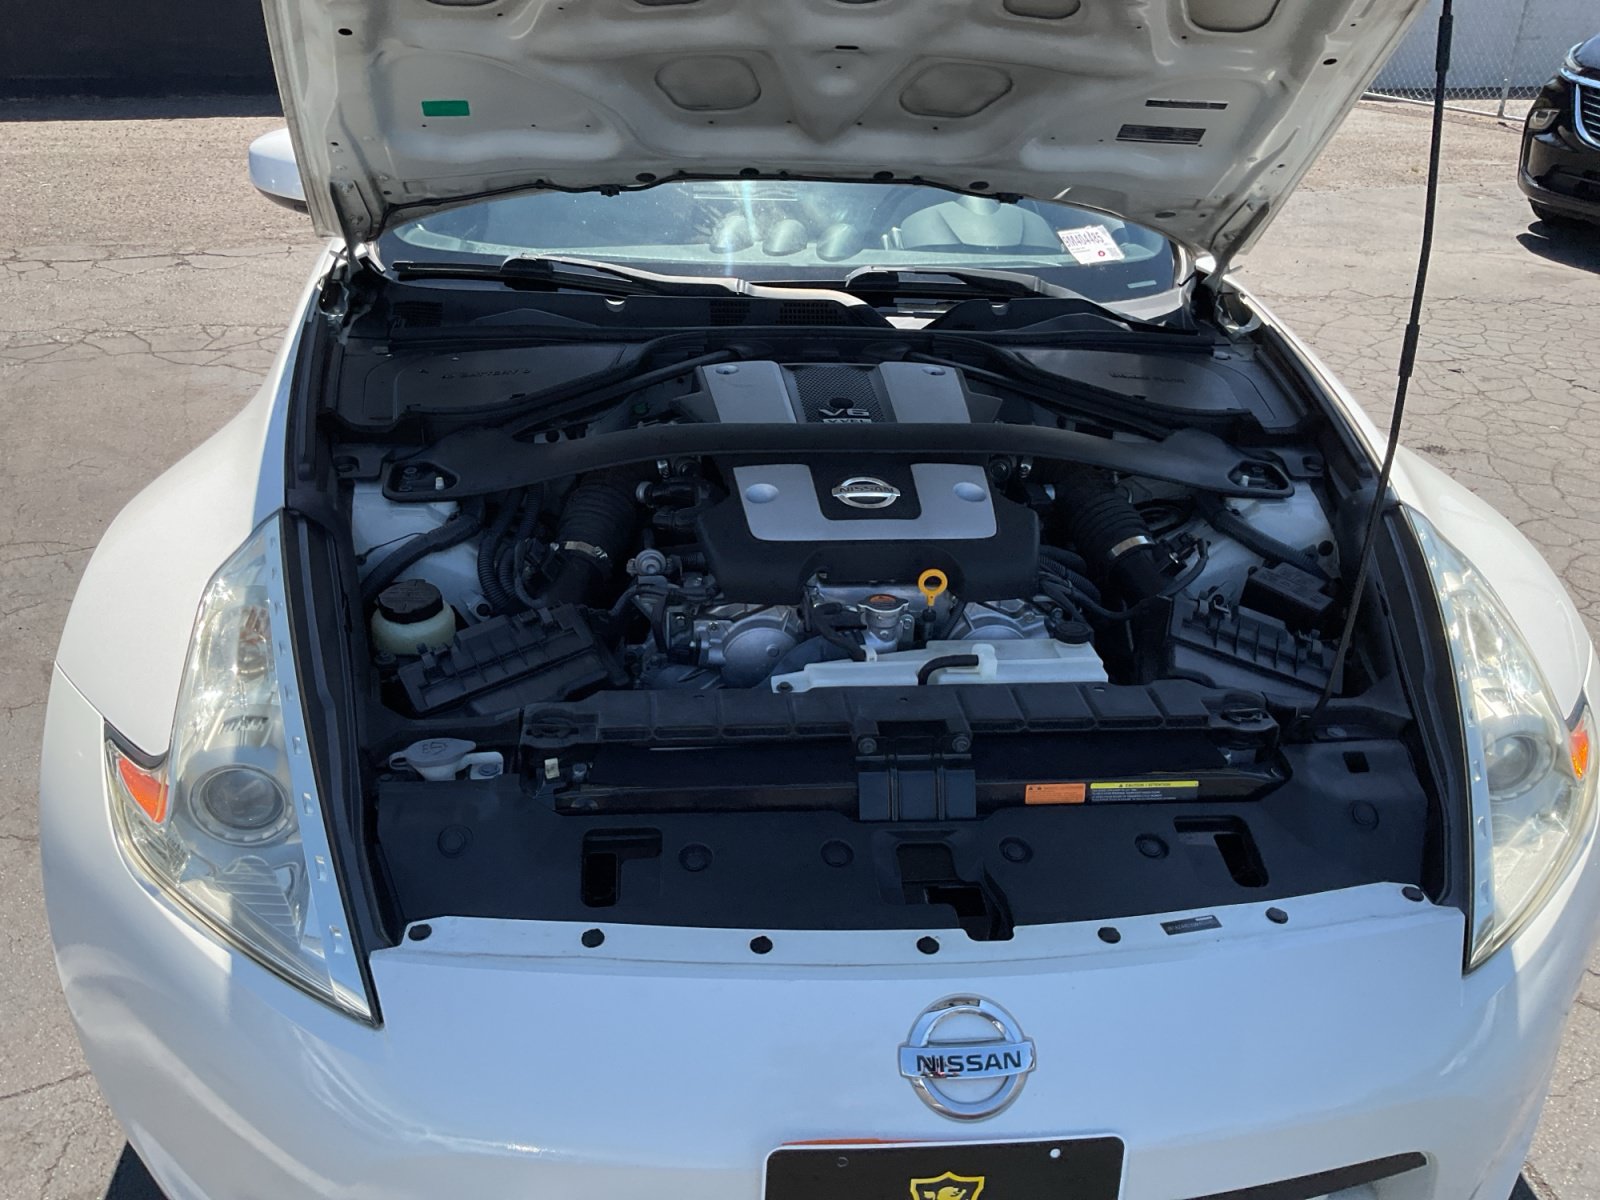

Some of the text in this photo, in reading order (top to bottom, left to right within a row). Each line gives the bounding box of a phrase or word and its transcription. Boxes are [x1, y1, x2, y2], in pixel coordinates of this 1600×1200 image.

[819, 408, 870, 416] V6
[839, 485, 894, 493] NISSAN
[916, 1050, 1022, 1073] NISSAN
